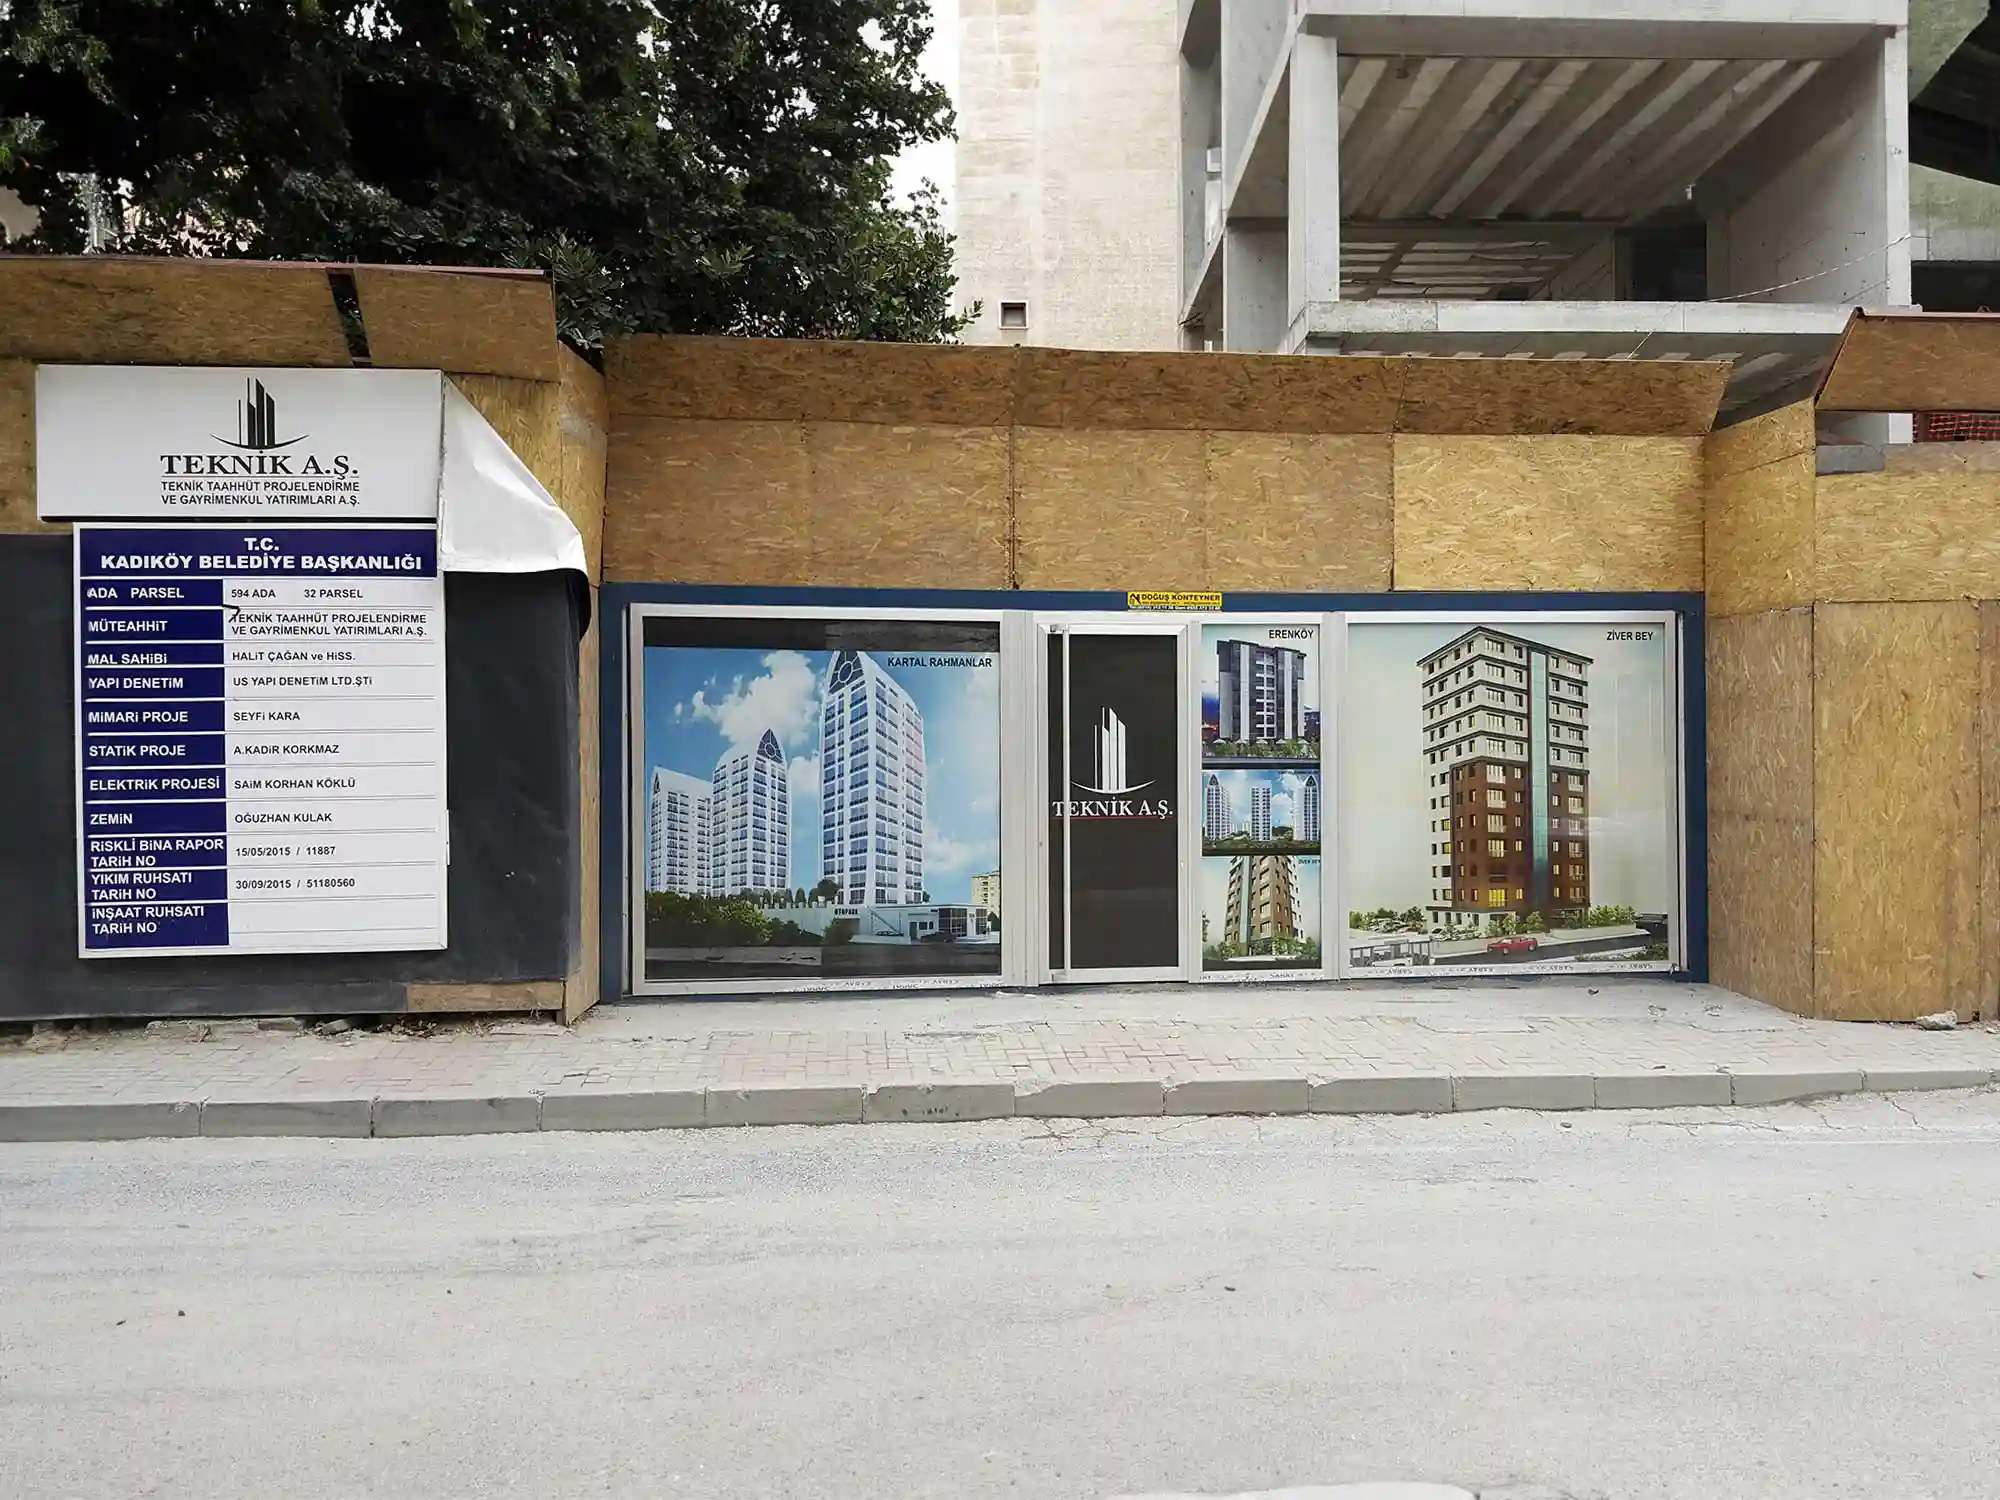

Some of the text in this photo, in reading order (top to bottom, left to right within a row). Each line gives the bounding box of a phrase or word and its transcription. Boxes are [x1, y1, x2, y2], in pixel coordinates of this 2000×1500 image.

[160, 450, 358, 480] TEKNİK A.Ş.
[161, 479, 360, 492] TEKNİK TAAHHÜT PROJELENDİRME
[161, 493, 360, 507] VE GAYRİMENKUL YATIRIMLARI A.Ş.
[244, 538, 279, 551] T.C.
[101, 552, 422, 573] KADIKÖY BELEDİYE BAŞKANLIĞI
[88, 587, 184, 599] ADA PARSEL
[231, 589, 363, 598] 594 ADA 32 PARSEL
[232, 612, 426, 623] TEKNİK TAAHHÜT PROJELENDİRME
[232, 624, 427, 637] VE GAYRİMENKUL YATIRIMLARI A.Ş.
[1636, 632, 1654, 640] BEY
[88, 653, 118, 665] MAL
[268, 650, 308, 662] ÇAĞAN
[888, 657, 992, 668] KARTAL RAHMANLAR
[88, 678, 119, 689] YAPI
[233, 677, 249, 686] US
[252, 677, 277, 686] YAPI
[142, 712, 188, 722] PROJE
[268, 712, 300, 721] KARA
[140, 745, 186, 756] PROJE
[282, 745, 339, 754] KORKMAZ
[265, 779, 312, 788] KORHAN
[316, 778, 355, 788] KÖKLÜ
[1052, 796, 1174, 820] TEKNİK A.Ş.
[235, 812, 332, 823] OĞUZHAN KULAK
[176, 839, 224, 850] RAPOR
[236, 847, 291, 857] 15/05/2015
[306, 846, 335, 855] 11887
[136, 856, 156, 867] NO
[91, 873, 192, 884] YIKIM RUHSATI
[236, 879, 291, 889] 30/09/2015
[306, 878, 355, 888] 51180560
[136, 888, 156, 899] NO
[145, 906, 204, 917] RUHSATI
[136, 922, 157, 933] NO
